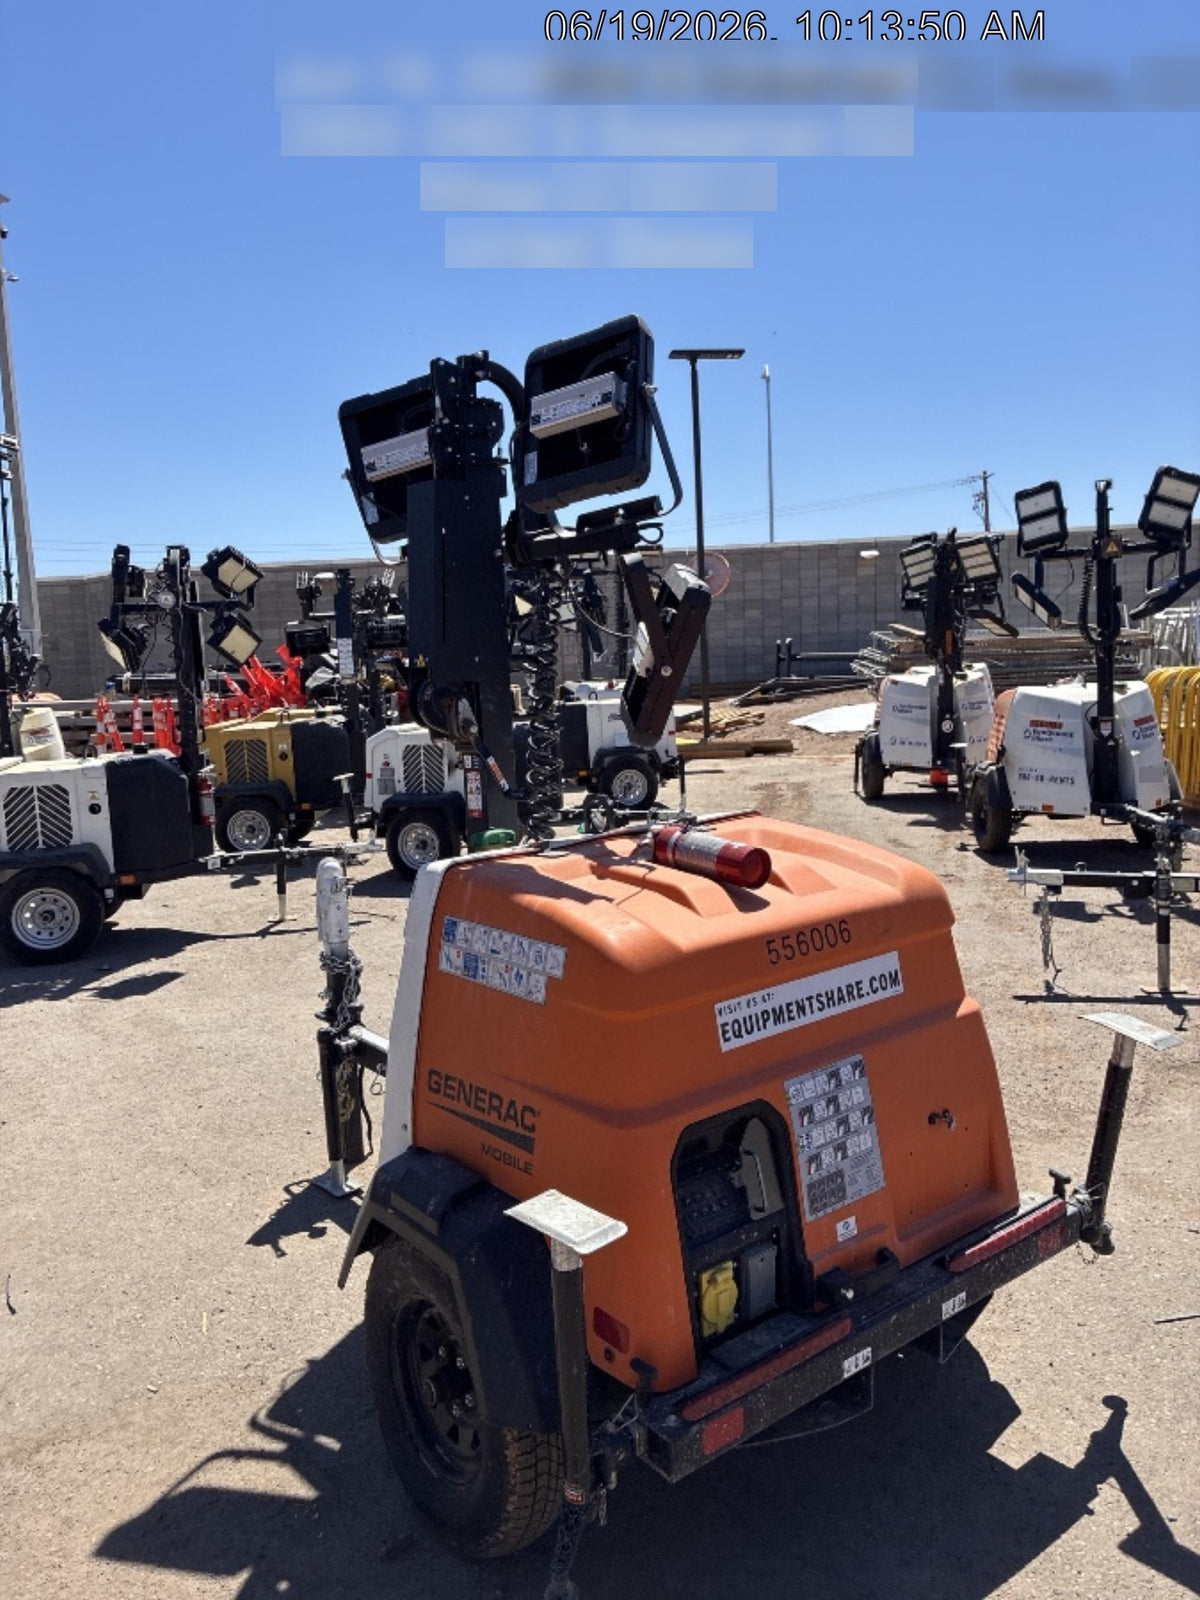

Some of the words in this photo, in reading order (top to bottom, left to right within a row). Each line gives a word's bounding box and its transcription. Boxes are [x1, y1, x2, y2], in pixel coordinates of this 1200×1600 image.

[766, 918, 852, 965] 556006
[717, 1000, 743, 1018] VISIT
[719, 969, 901, 1043] EQUIPMENTSHARE.COM
[427, 1067, 536, 1133] GENERAC
[481, 1142, 534, 1176] MOBILE
